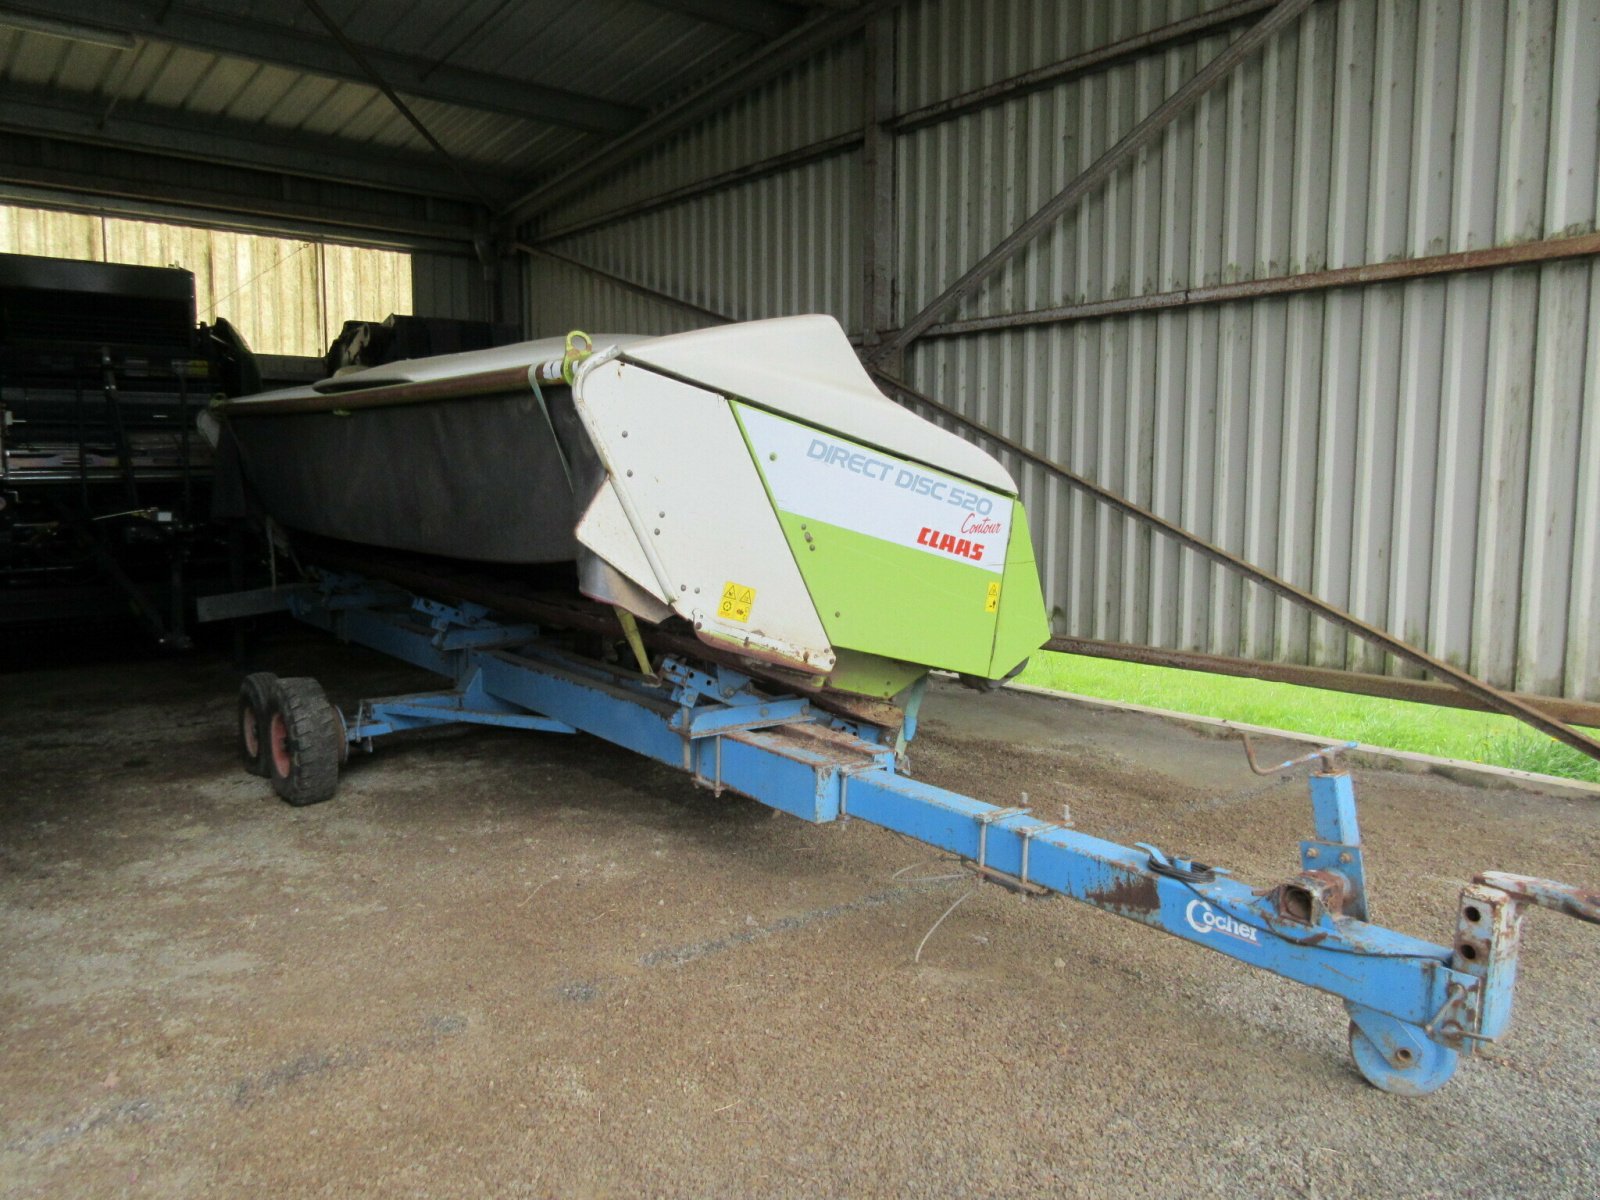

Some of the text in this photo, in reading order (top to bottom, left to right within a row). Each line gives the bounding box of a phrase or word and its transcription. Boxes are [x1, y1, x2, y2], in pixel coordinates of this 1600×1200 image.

[806, 439, 993, 516] DIRECT DISC 520
[961, 513, 1003, 534] Contour
[917, 527, 985, 561] CLAAS
